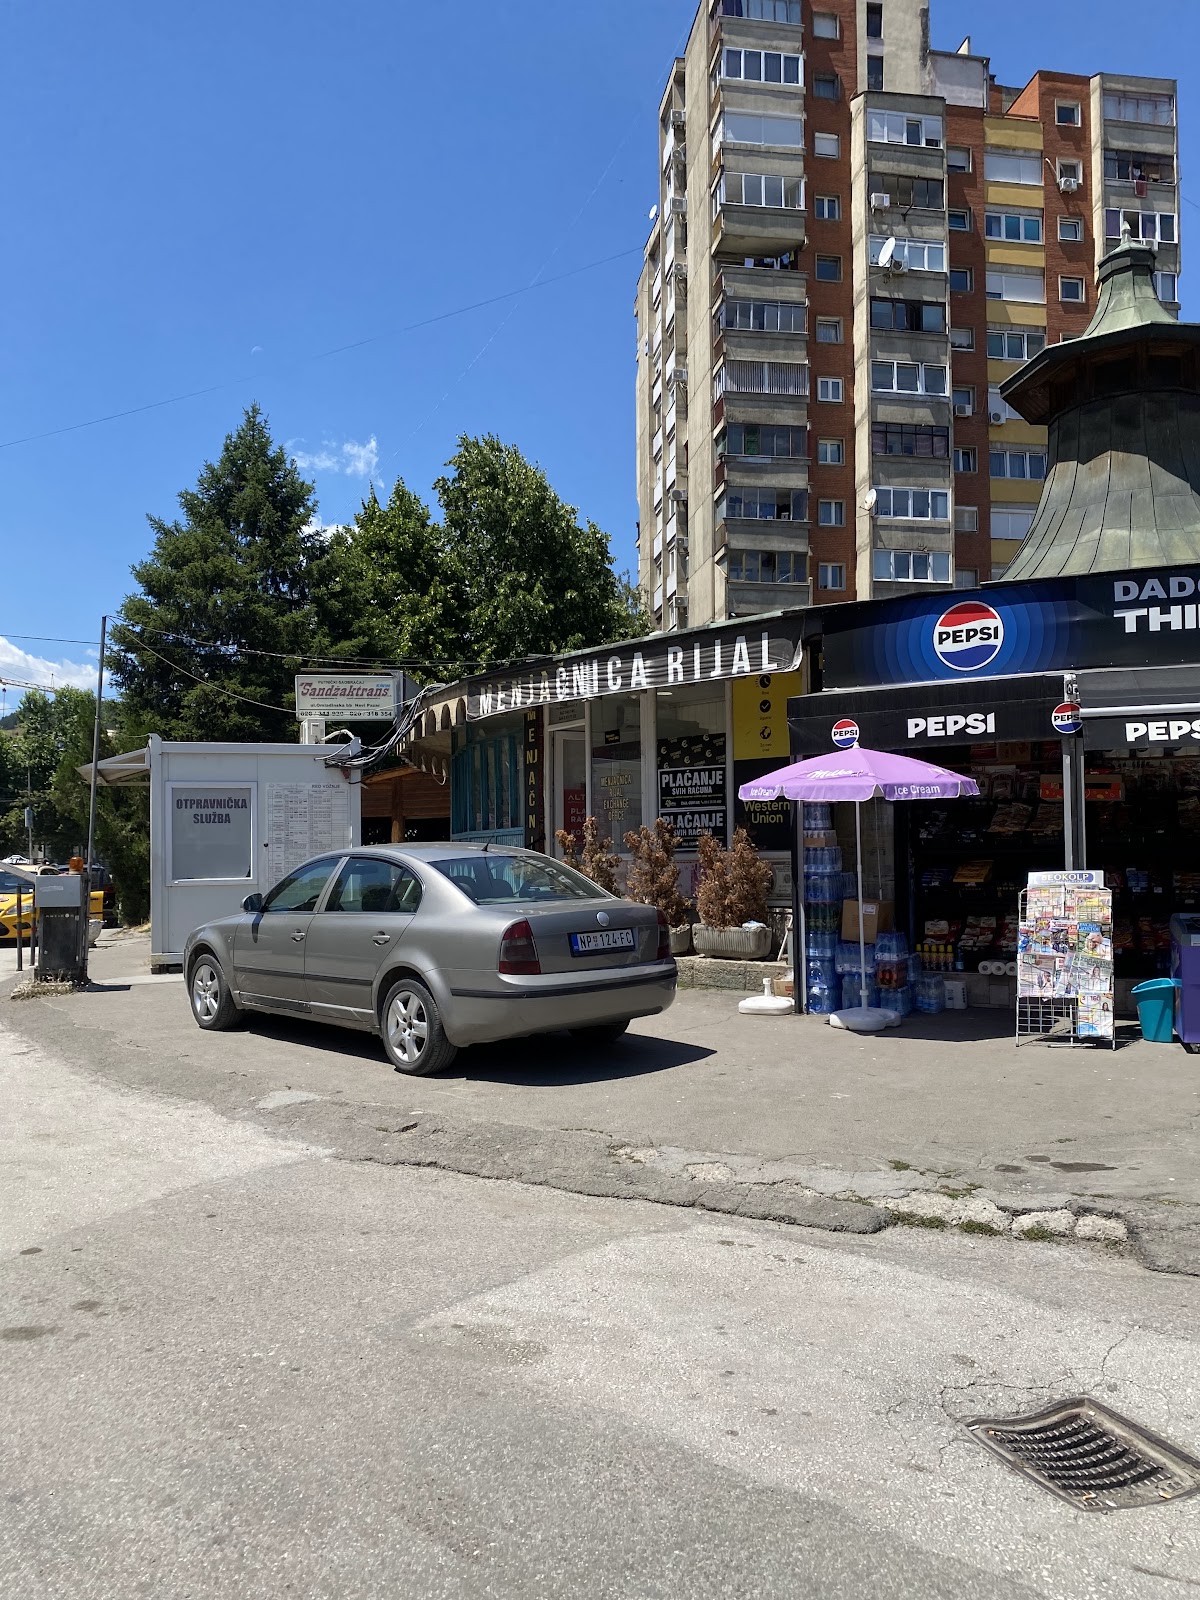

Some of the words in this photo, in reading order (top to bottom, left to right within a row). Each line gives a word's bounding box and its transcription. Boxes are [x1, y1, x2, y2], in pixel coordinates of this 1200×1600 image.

[1114, 577, 1200, 602] DAD
[1113, 604, 1200, 634] THI
[937, 625, 999, 645] PEPSI
[479, 651, 648, 715] MENJAČNICA
[667, 631, 778, 683] RIJAL
[299, 682, 390, 697] Sandžaktrans
[1053, 713, 1080, 722] PEPS
[907, 712, 996, 738] PEPSI
[1125, 719, 1200, 742] PEPS
[832, 726, 859, 738] PEPSI
[661, 770, 724, 788] PLAĆANJE
[672, 786, 687, 796] SVIH
[894, 785, 909, 795] Ice
[909, 784, 941, 794] Cream
[176, 796, 248, 809] OTPRAVNIČKA
[743, 801, 791, 812] Western
[193, 811, 232, 824] SLUŽBA
[751, 811, 784, 824] Union
[1041, 873, 1089, 881] BEOKOLP
[579, 935, 592, 949] NP
